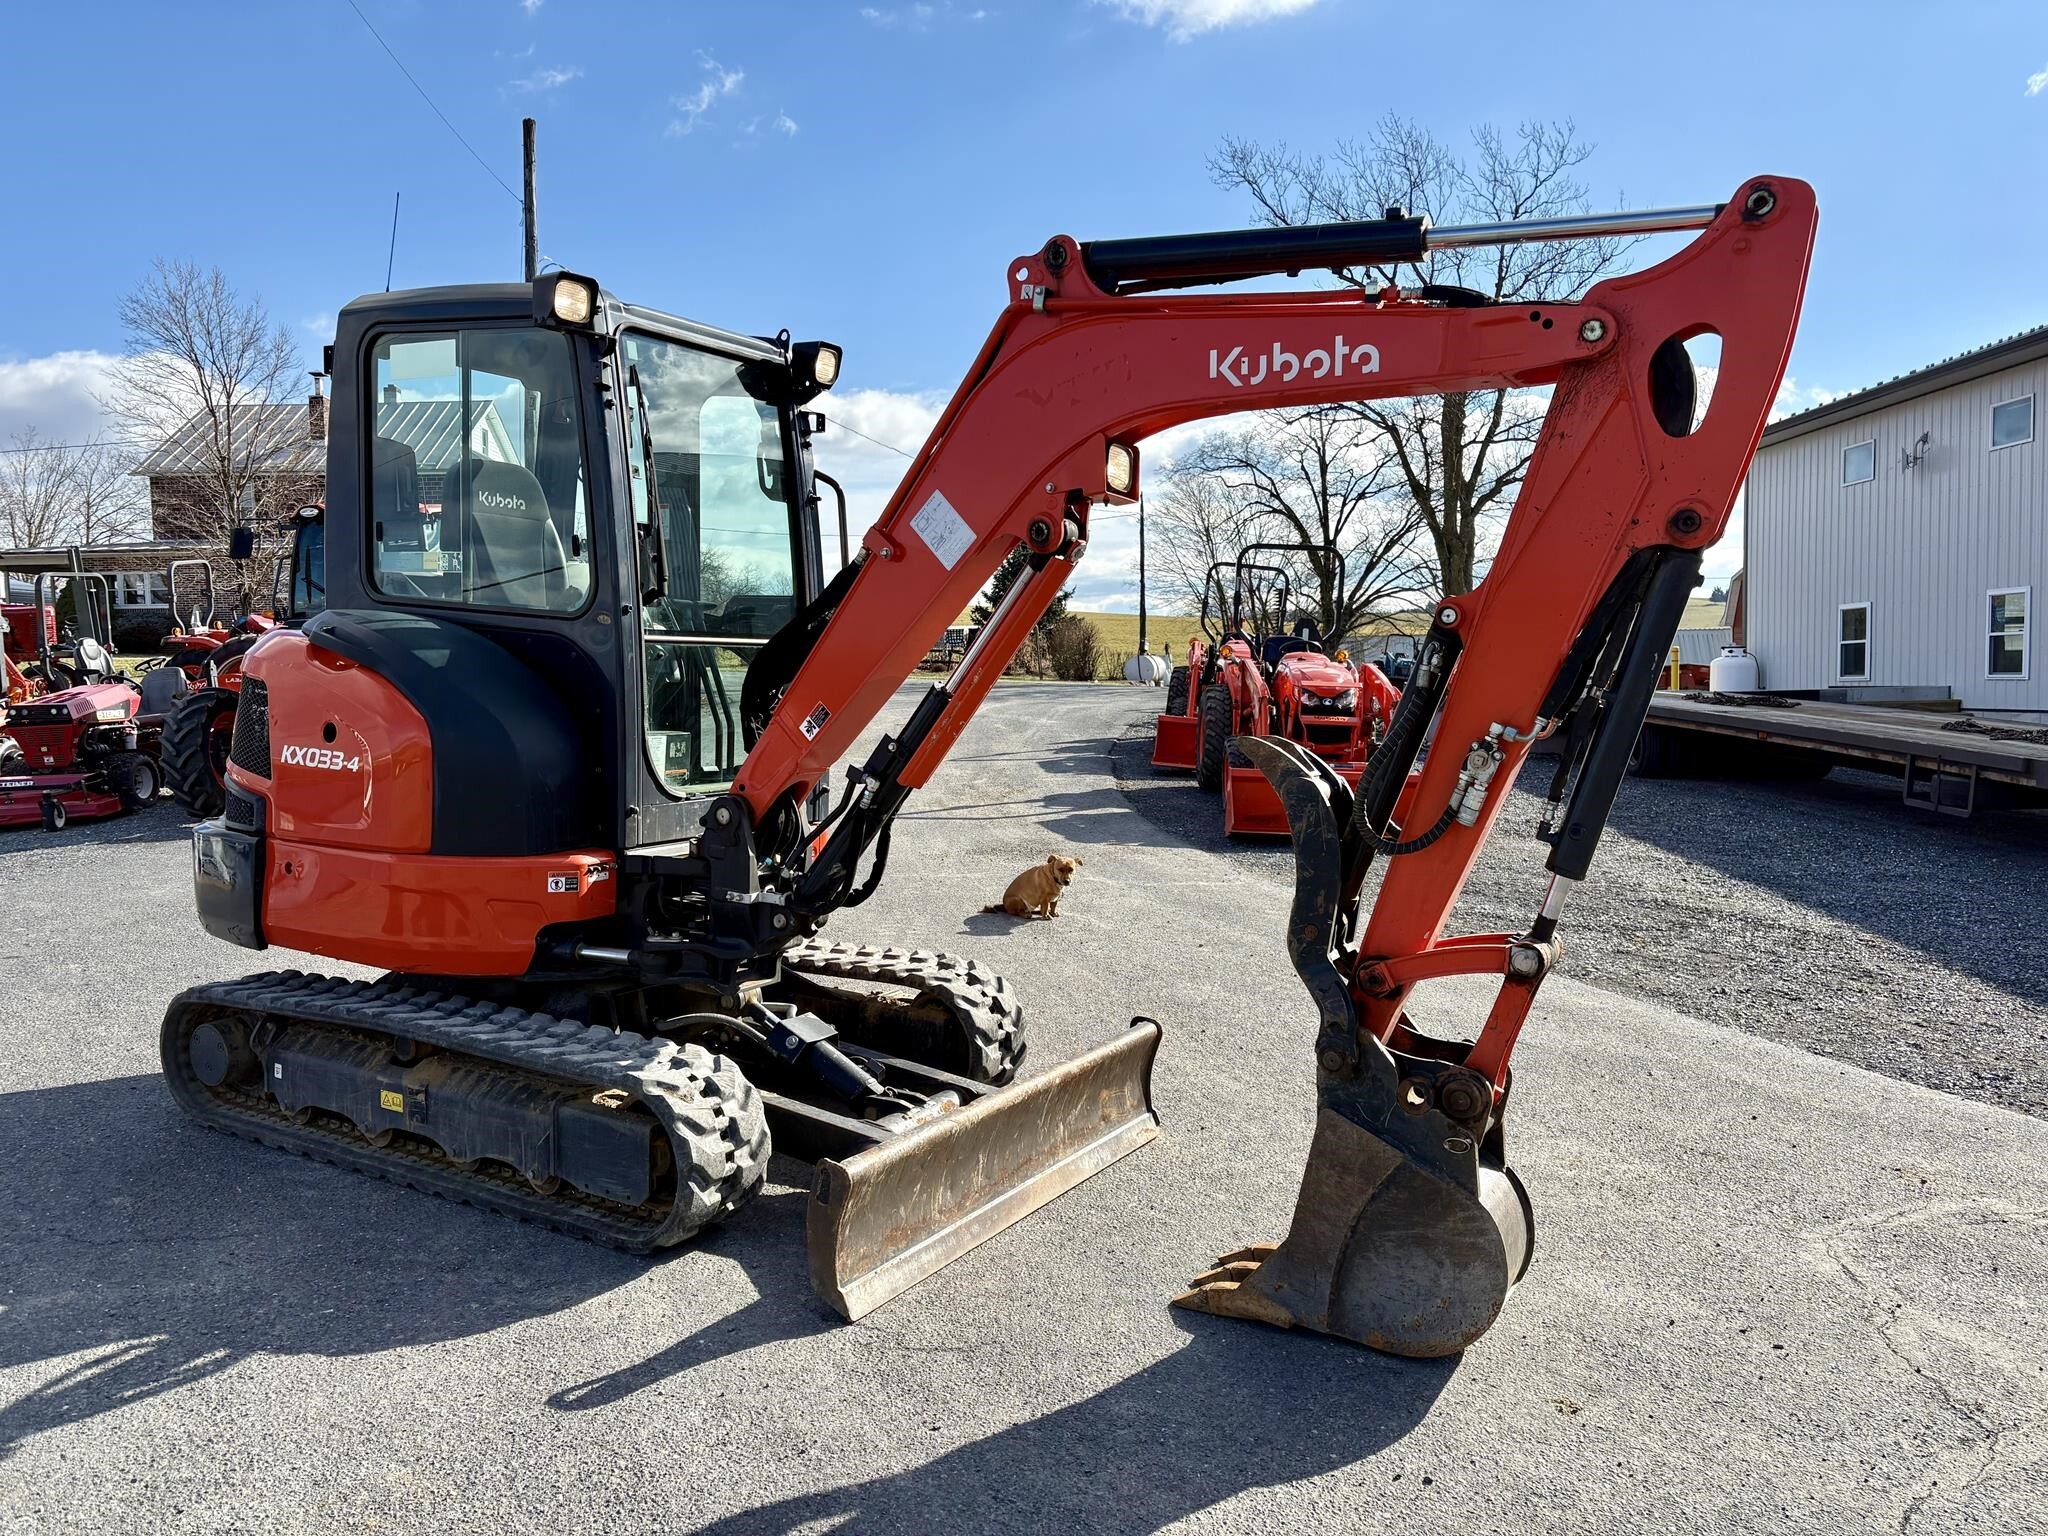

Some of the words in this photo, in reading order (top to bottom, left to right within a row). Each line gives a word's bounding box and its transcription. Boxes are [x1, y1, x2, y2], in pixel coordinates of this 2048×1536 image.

[1209, 335, 1380, 387] Kubota
[479, 490, 526, 510] Kubota
[280, 744, 360, 773] KX033-4
